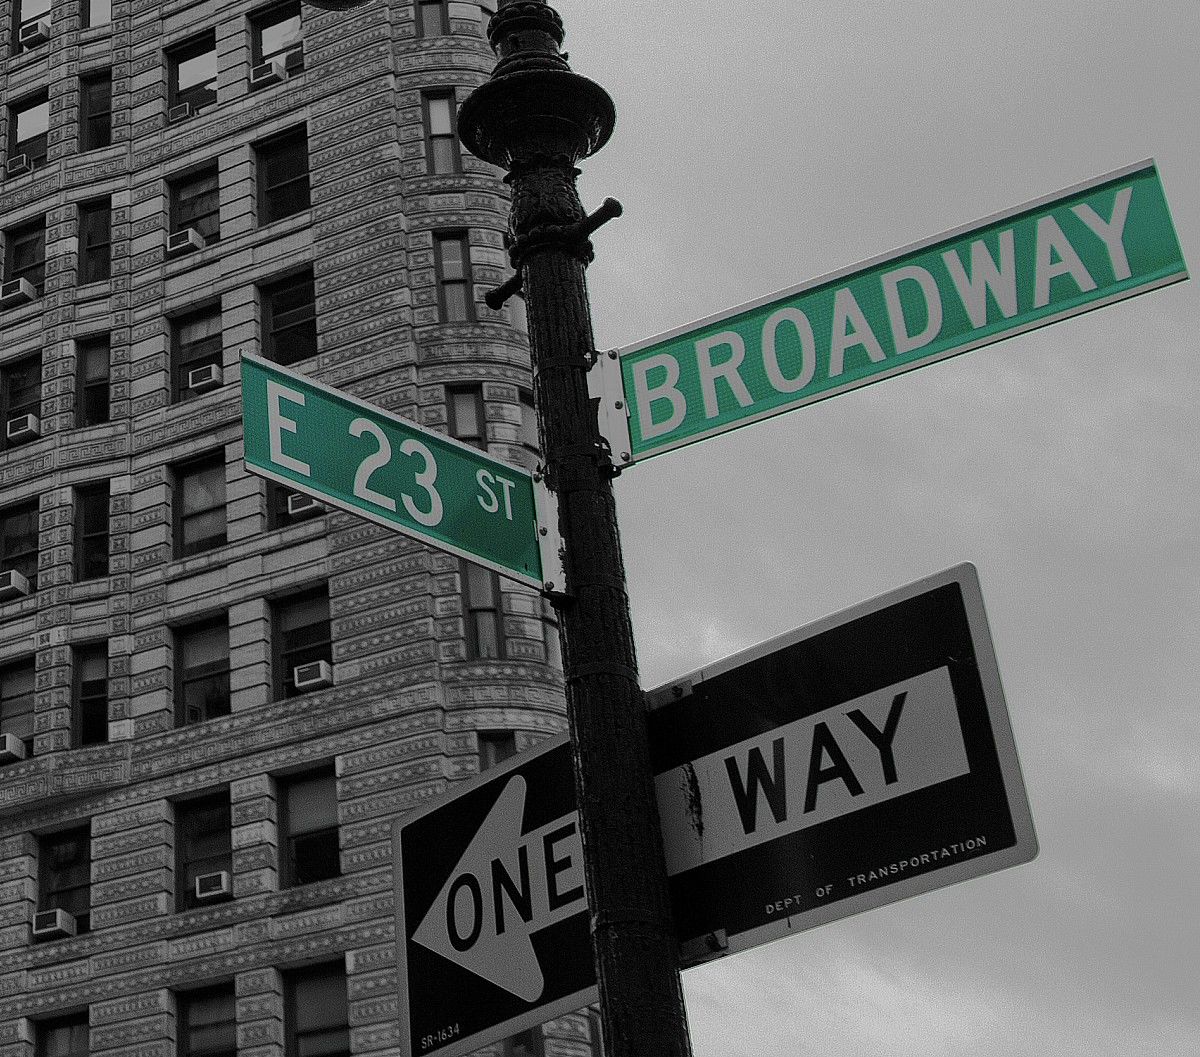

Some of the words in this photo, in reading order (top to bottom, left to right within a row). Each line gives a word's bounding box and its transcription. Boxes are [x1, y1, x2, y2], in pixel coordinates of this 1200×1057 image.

[632, 187, 1133, 442] BROADWAY
[266, 379, 311, 477] E
[349, 418, 444, 527] 23
[475, 469, 516, 521] ST
[446, 822, 585, 952] ONE
[724, 692, 908, 835] WAY
[765, 894, 802, 915] DEPT
[815, 884, 834, 898] OF
[848, 835, 988, 888] TRANSPORTATION
[420, 1022, 460, 1050] SR-1634
